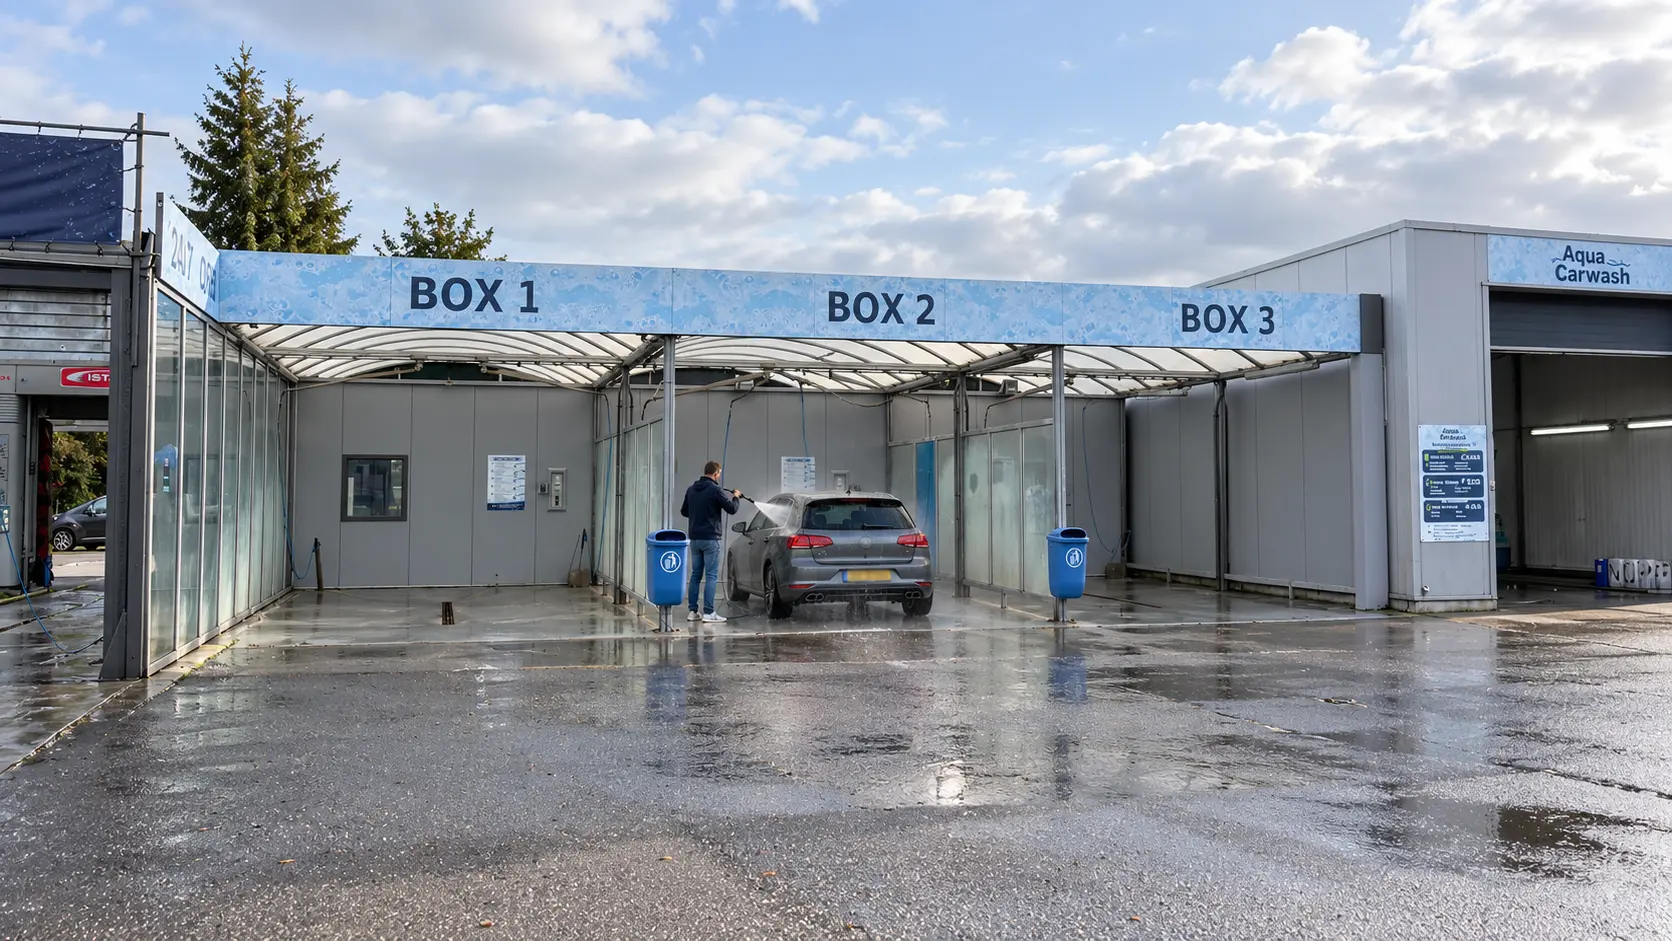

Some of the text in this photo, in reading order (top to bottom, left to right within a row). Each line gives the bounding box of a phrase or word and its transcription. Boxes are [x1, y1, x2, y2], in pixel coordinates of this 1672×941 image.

[1562, 245, 1605, 267] Aqua
[1554, 264, 1631, 285] Carwash
[410, 276, 539, 313] BOX 1
[828, 290, 936, 326] BOX 2
[1181, 303, 1275, 335] BOX 3
[87, 373, 110, 382] IST
